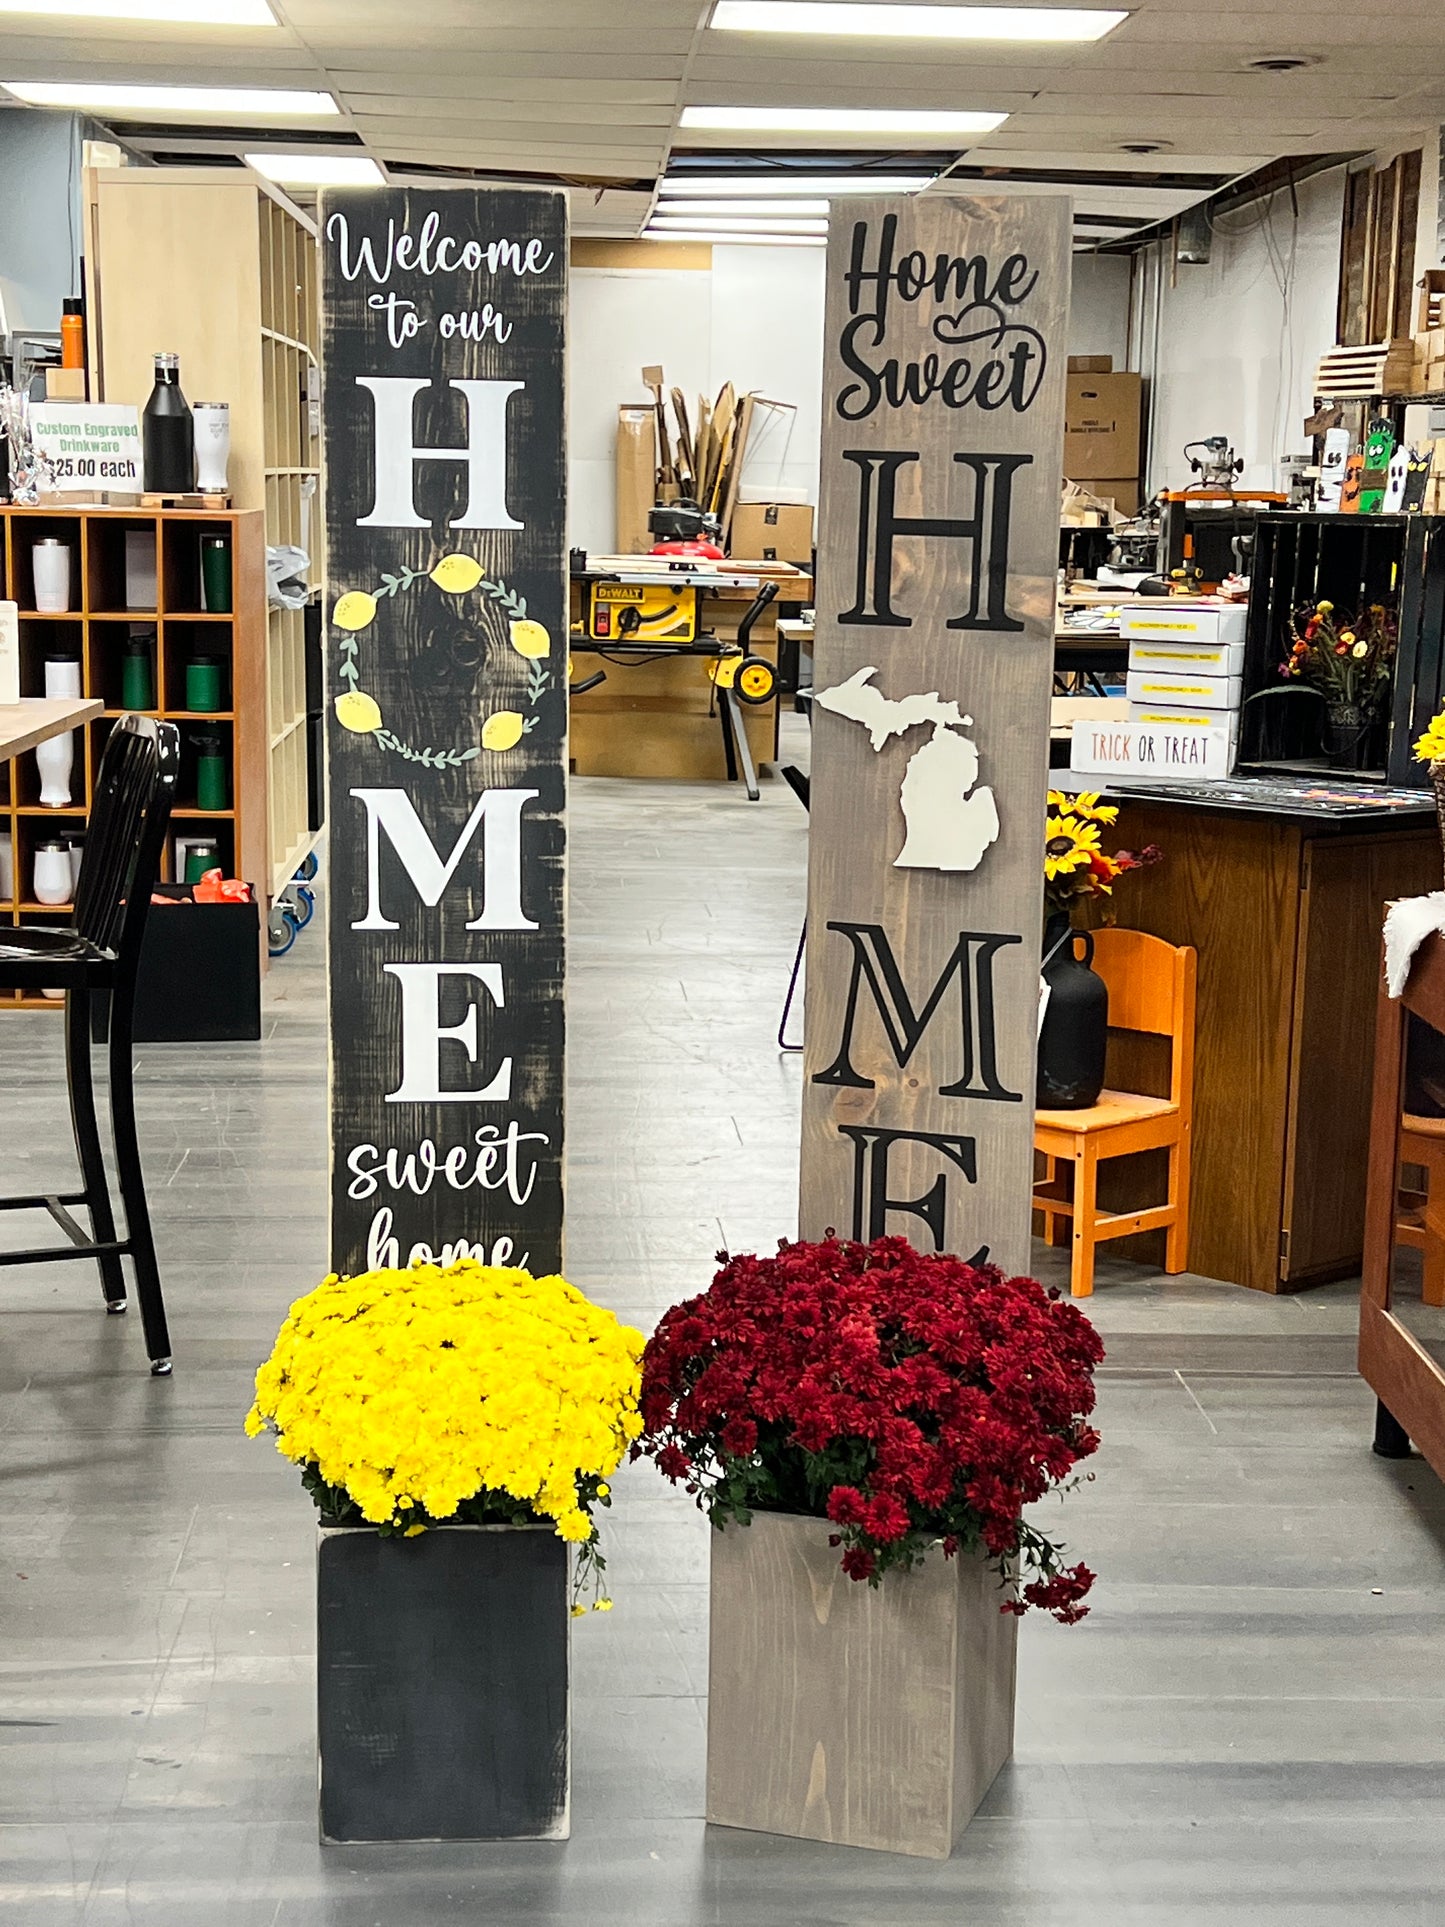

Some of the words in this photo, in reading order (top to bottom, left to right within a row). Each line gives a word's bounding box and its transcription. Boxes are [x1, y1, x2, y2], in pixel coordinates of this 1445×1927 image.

[326, 211, 555, 284] Welcome
[844, 213, 1040, 320] Home
[367, 291, 428, 349] to
[439, 303, 513, 344] our
[836, 303, 1047, 421] Sweet
[36, 422, 82, 436] Custom
[84, 424, 138, 438] Engraved
[59, 438, 120, 453] Drinkware
[100, 459, 136, 478] each
[1091, 733, 1131, 761] TRICK
[1138, 735, 1155, 762] OR
[1164, 736, 1209, 764] TREAT
[347, 1120, 550, 1206] sweet
